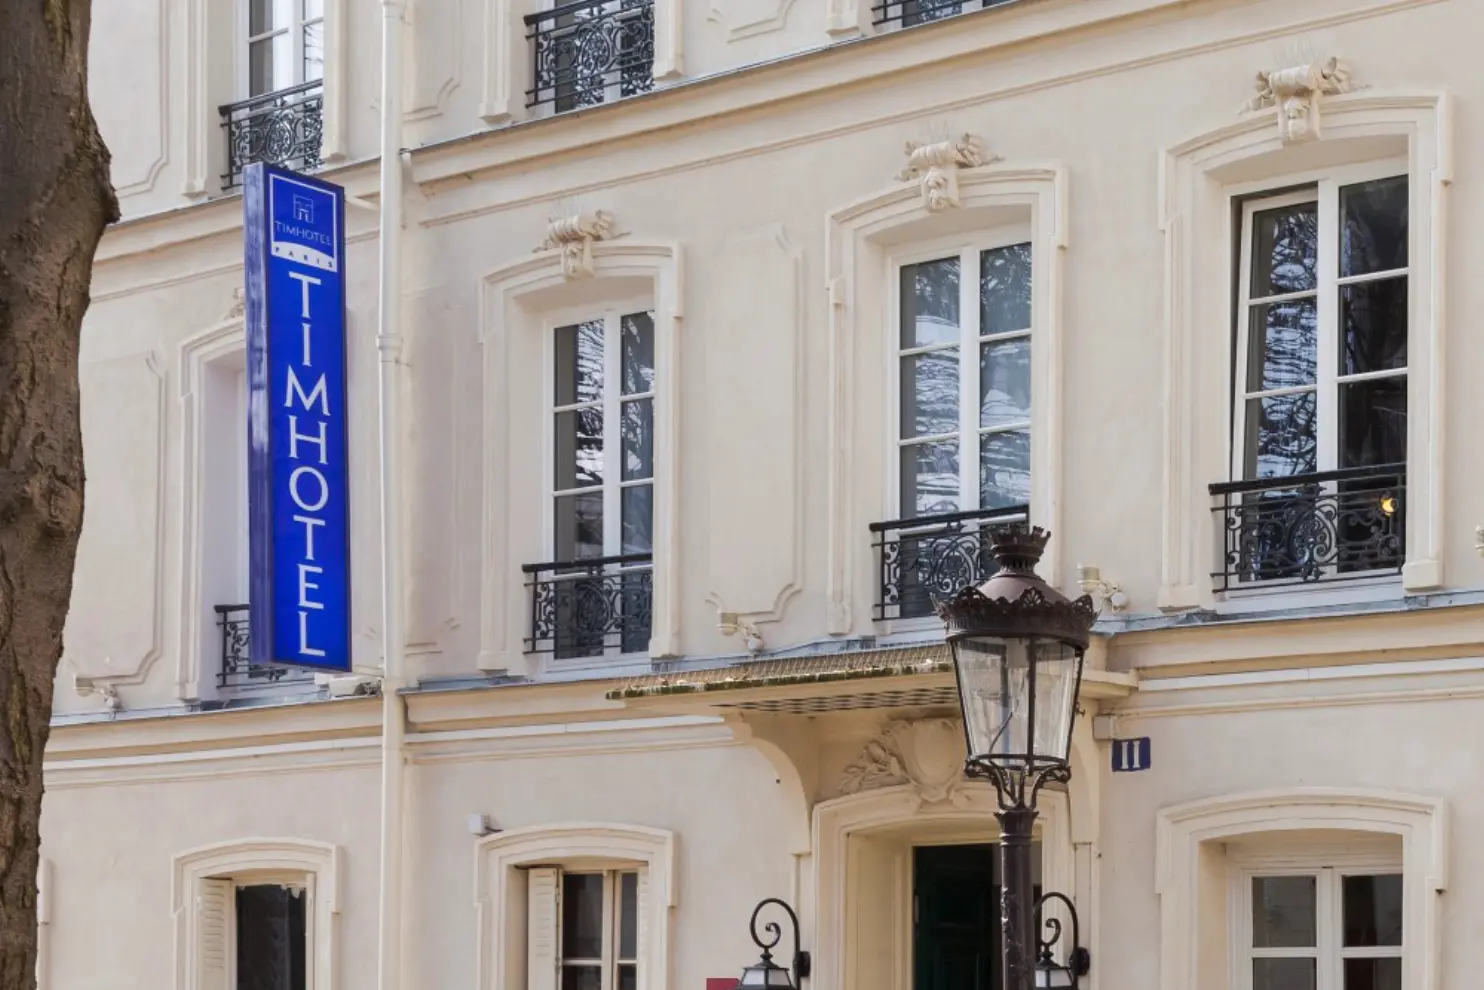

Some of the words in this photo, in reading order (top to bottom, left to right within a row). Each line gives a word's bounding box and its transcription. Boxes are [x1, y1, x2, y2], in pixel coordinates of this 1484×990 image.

[274, 220, 332, 247] TIMHOTEL
[275, 246, 333, 268] PARIS
[284, 271, 332, 658] TIMHOTEL
[1121, 740, 1141, 770] 11
